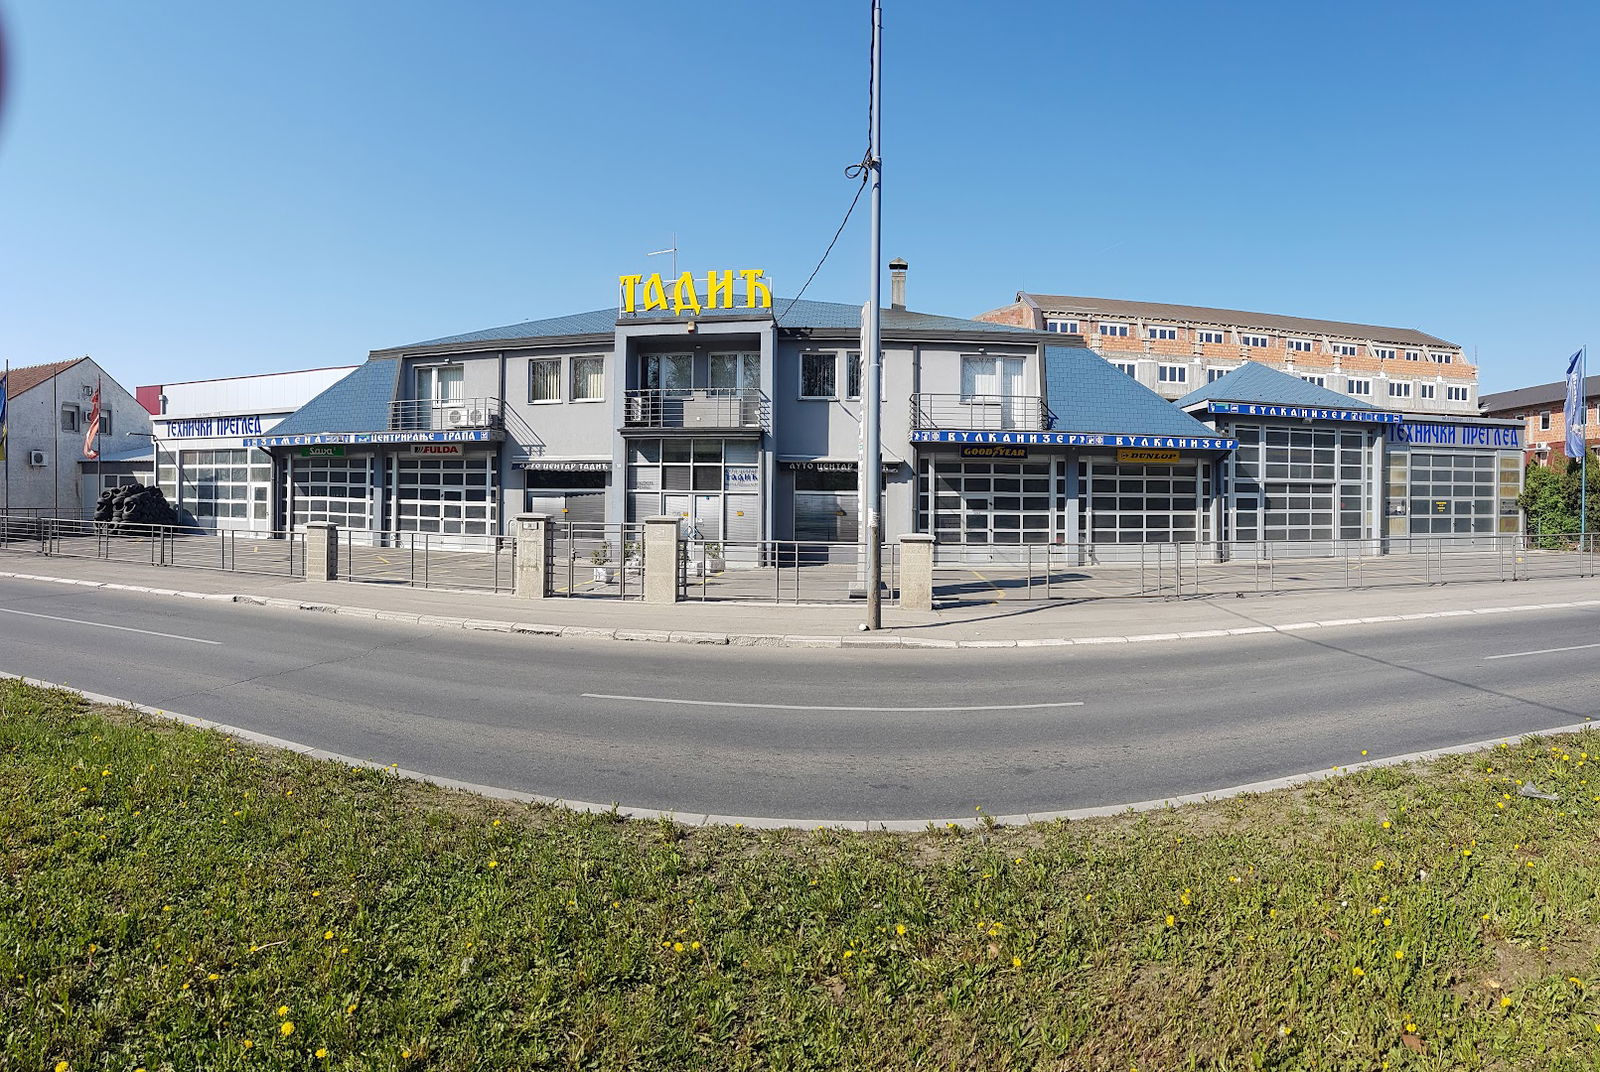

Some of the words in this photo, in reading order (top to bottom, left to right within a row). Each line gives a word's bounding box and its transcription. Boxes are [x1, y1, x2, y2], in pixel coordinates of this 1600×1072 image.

[619, 269, 772, 316] ТАДИЋ
[1249, 405, 1346, 419] ВУЛКАНИЗЕР
[166, 419, 213, 438] ТЕХНИЧКИ
[216, 416, 262, 436] ПРЕГЛЕД
[260, 435, 322, 446] ЗАМЕНА
[370, 432, 434, 442] ЦЕНТРИРАЊЕ
[442, 431, 475, 441] ТРАПА
[947, 432, 1076, 444] ВУЛКАНИЗЕР
[1389, 423, 1456, 444] ТЕХНИЧКИ
[1462, 426, 1519, 447] ПРЕГЛЕД
[1115, 436, 1233, 449] ВУЛКАНИЗЕР
[423, 446, 459, 454] FULDA
